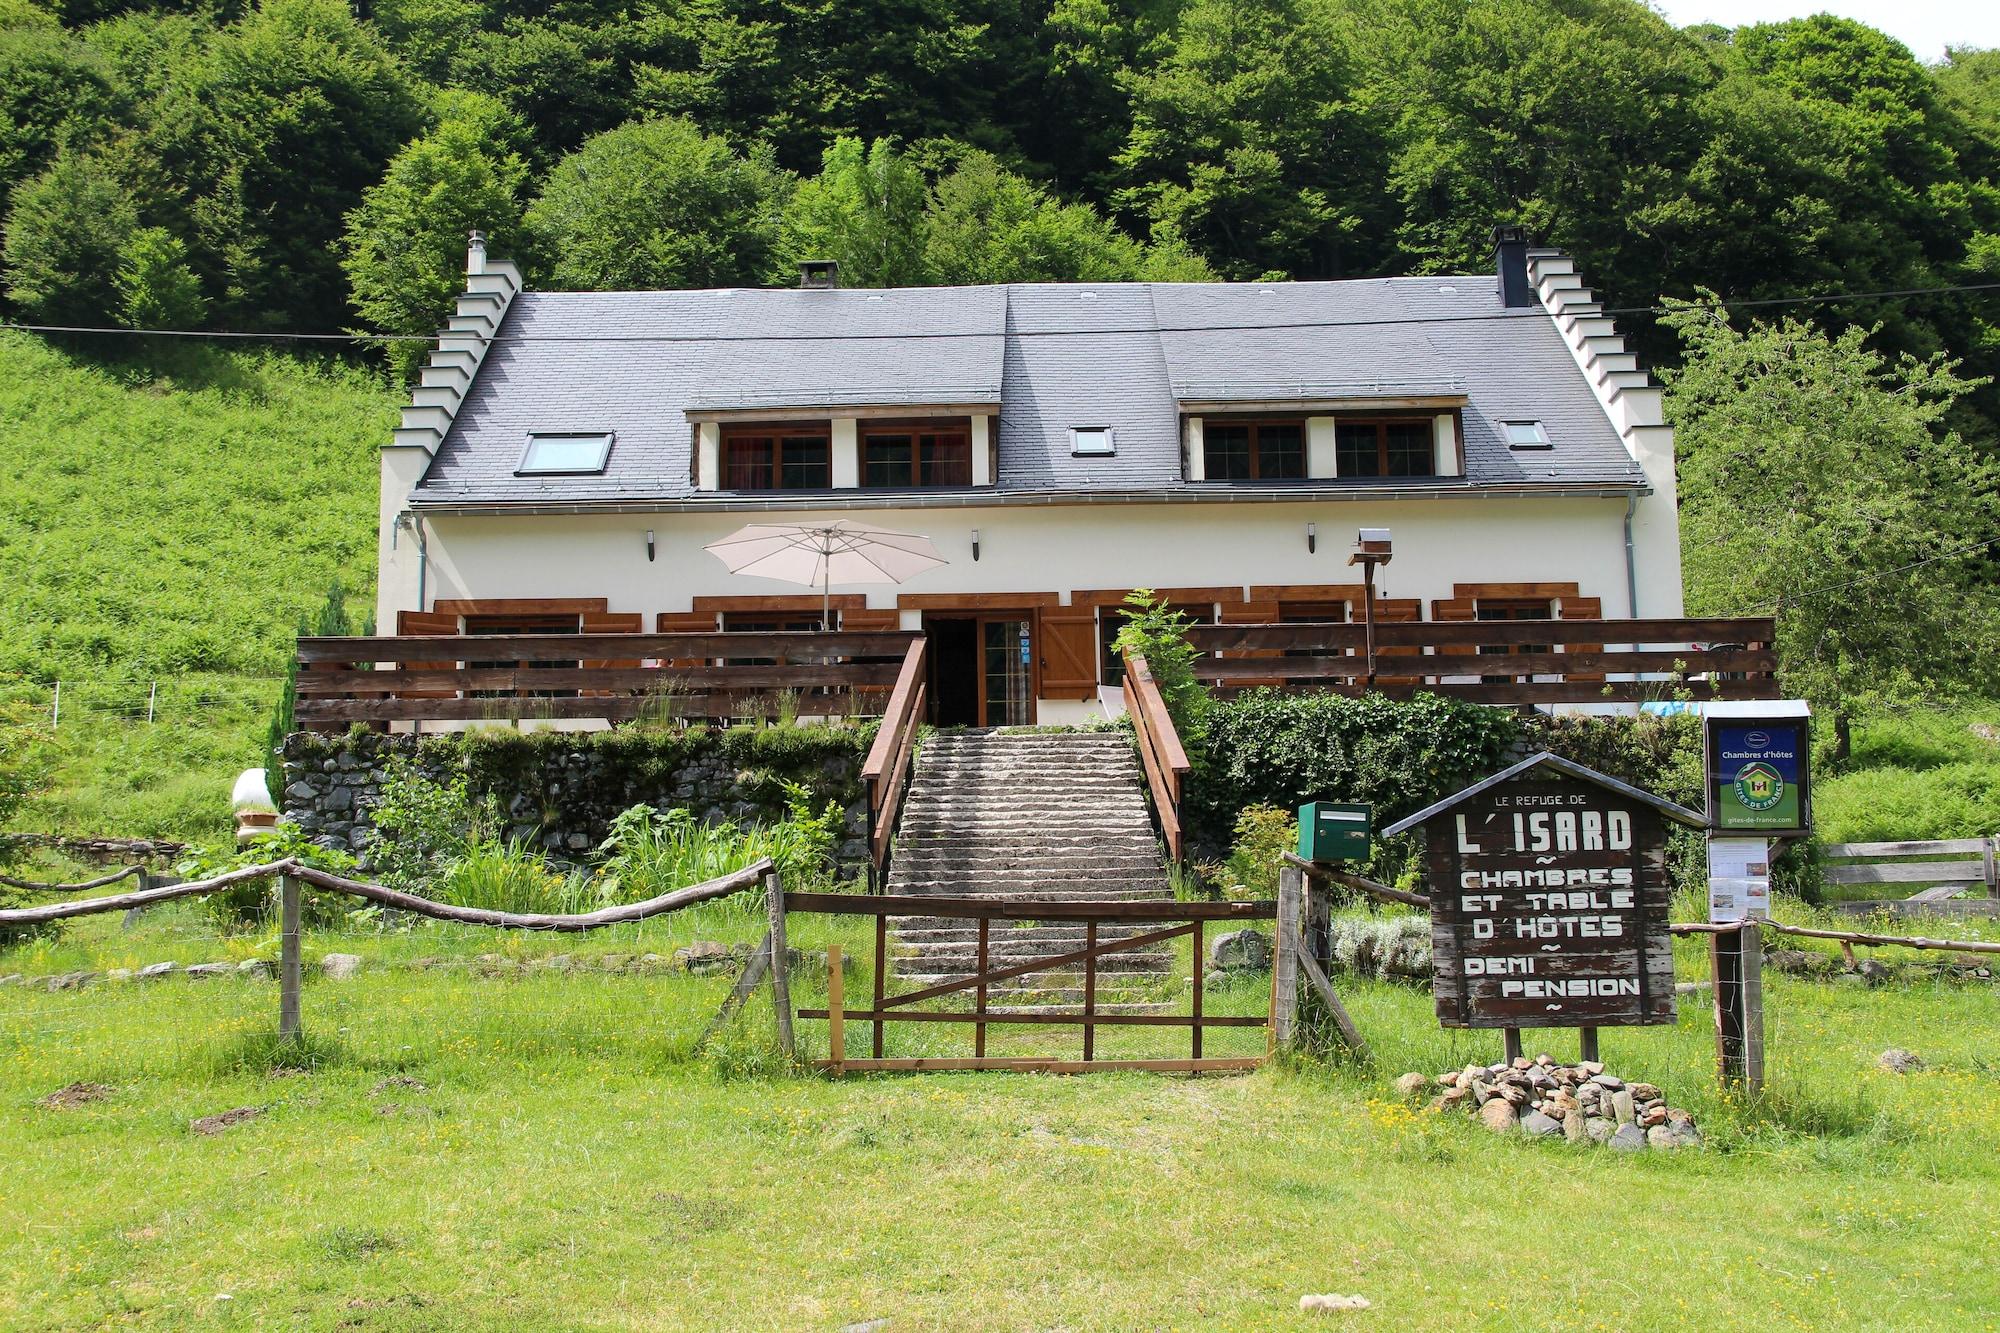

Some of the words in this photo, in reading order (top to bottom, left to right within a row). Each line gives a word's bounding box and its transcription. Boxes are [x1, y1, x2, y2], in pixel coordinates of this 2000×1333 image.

[1722, 751, 1761, 759] Chambres
[1763, 751, 1793, 759] d'hôtes
[1495, 796, 1509, 806] LE
[1516, 795, 1563, 806] REFUGE
[1570, 794, 1586, 805] DE
[1763, 782, 1782, 808] FRANCE
[1727, 816, 1792, 825] gites-de-france.com
[1460, 868, 1633, 889] CHAMBRES
[1461, 894, 1503, 912] ET
[1526, 891, 1635, 911] TABLE
[1463, 957, 1535, 975] DEMI
[1501, 978, 1641, 998] PENSION
